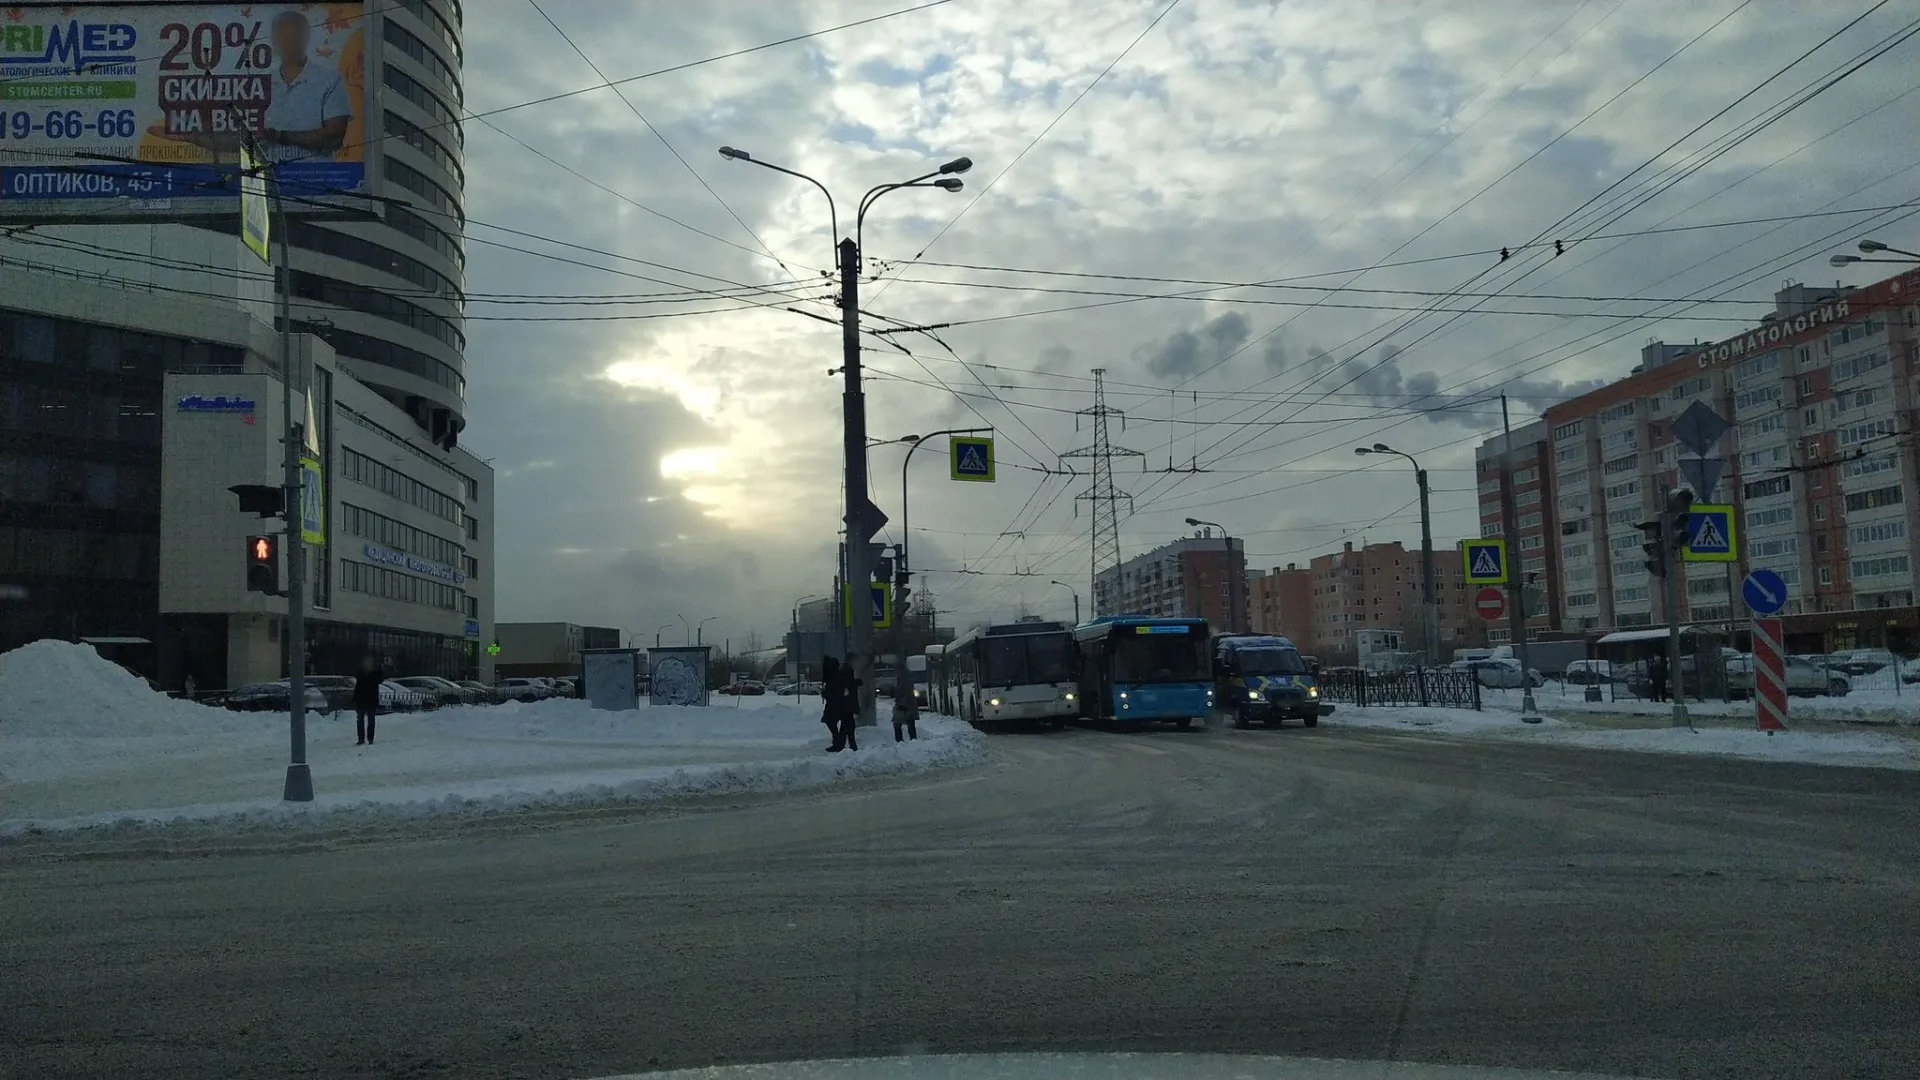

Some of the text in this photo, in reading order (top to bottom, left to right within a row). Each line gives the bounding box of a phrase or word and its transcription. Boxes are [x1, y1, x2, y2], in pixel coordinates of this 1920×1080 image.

[0, 20, 137, 75] RIMED
[159, 21, 273, 70] 20%
[90, 66, 137, 75] КЛИНИКИ
[8, 86, 103, 97] STOMCENTER.RU
[164, 79, 265, 101] СКИДКА
[0, 110, 136, 139] 19-66-66
[170, 109, 259, 132] НА ВСЕ
[127, 171, 173, 192] 45-1
[1697, 299, 1850, 369] СТОМАТОЛОГИЯ
